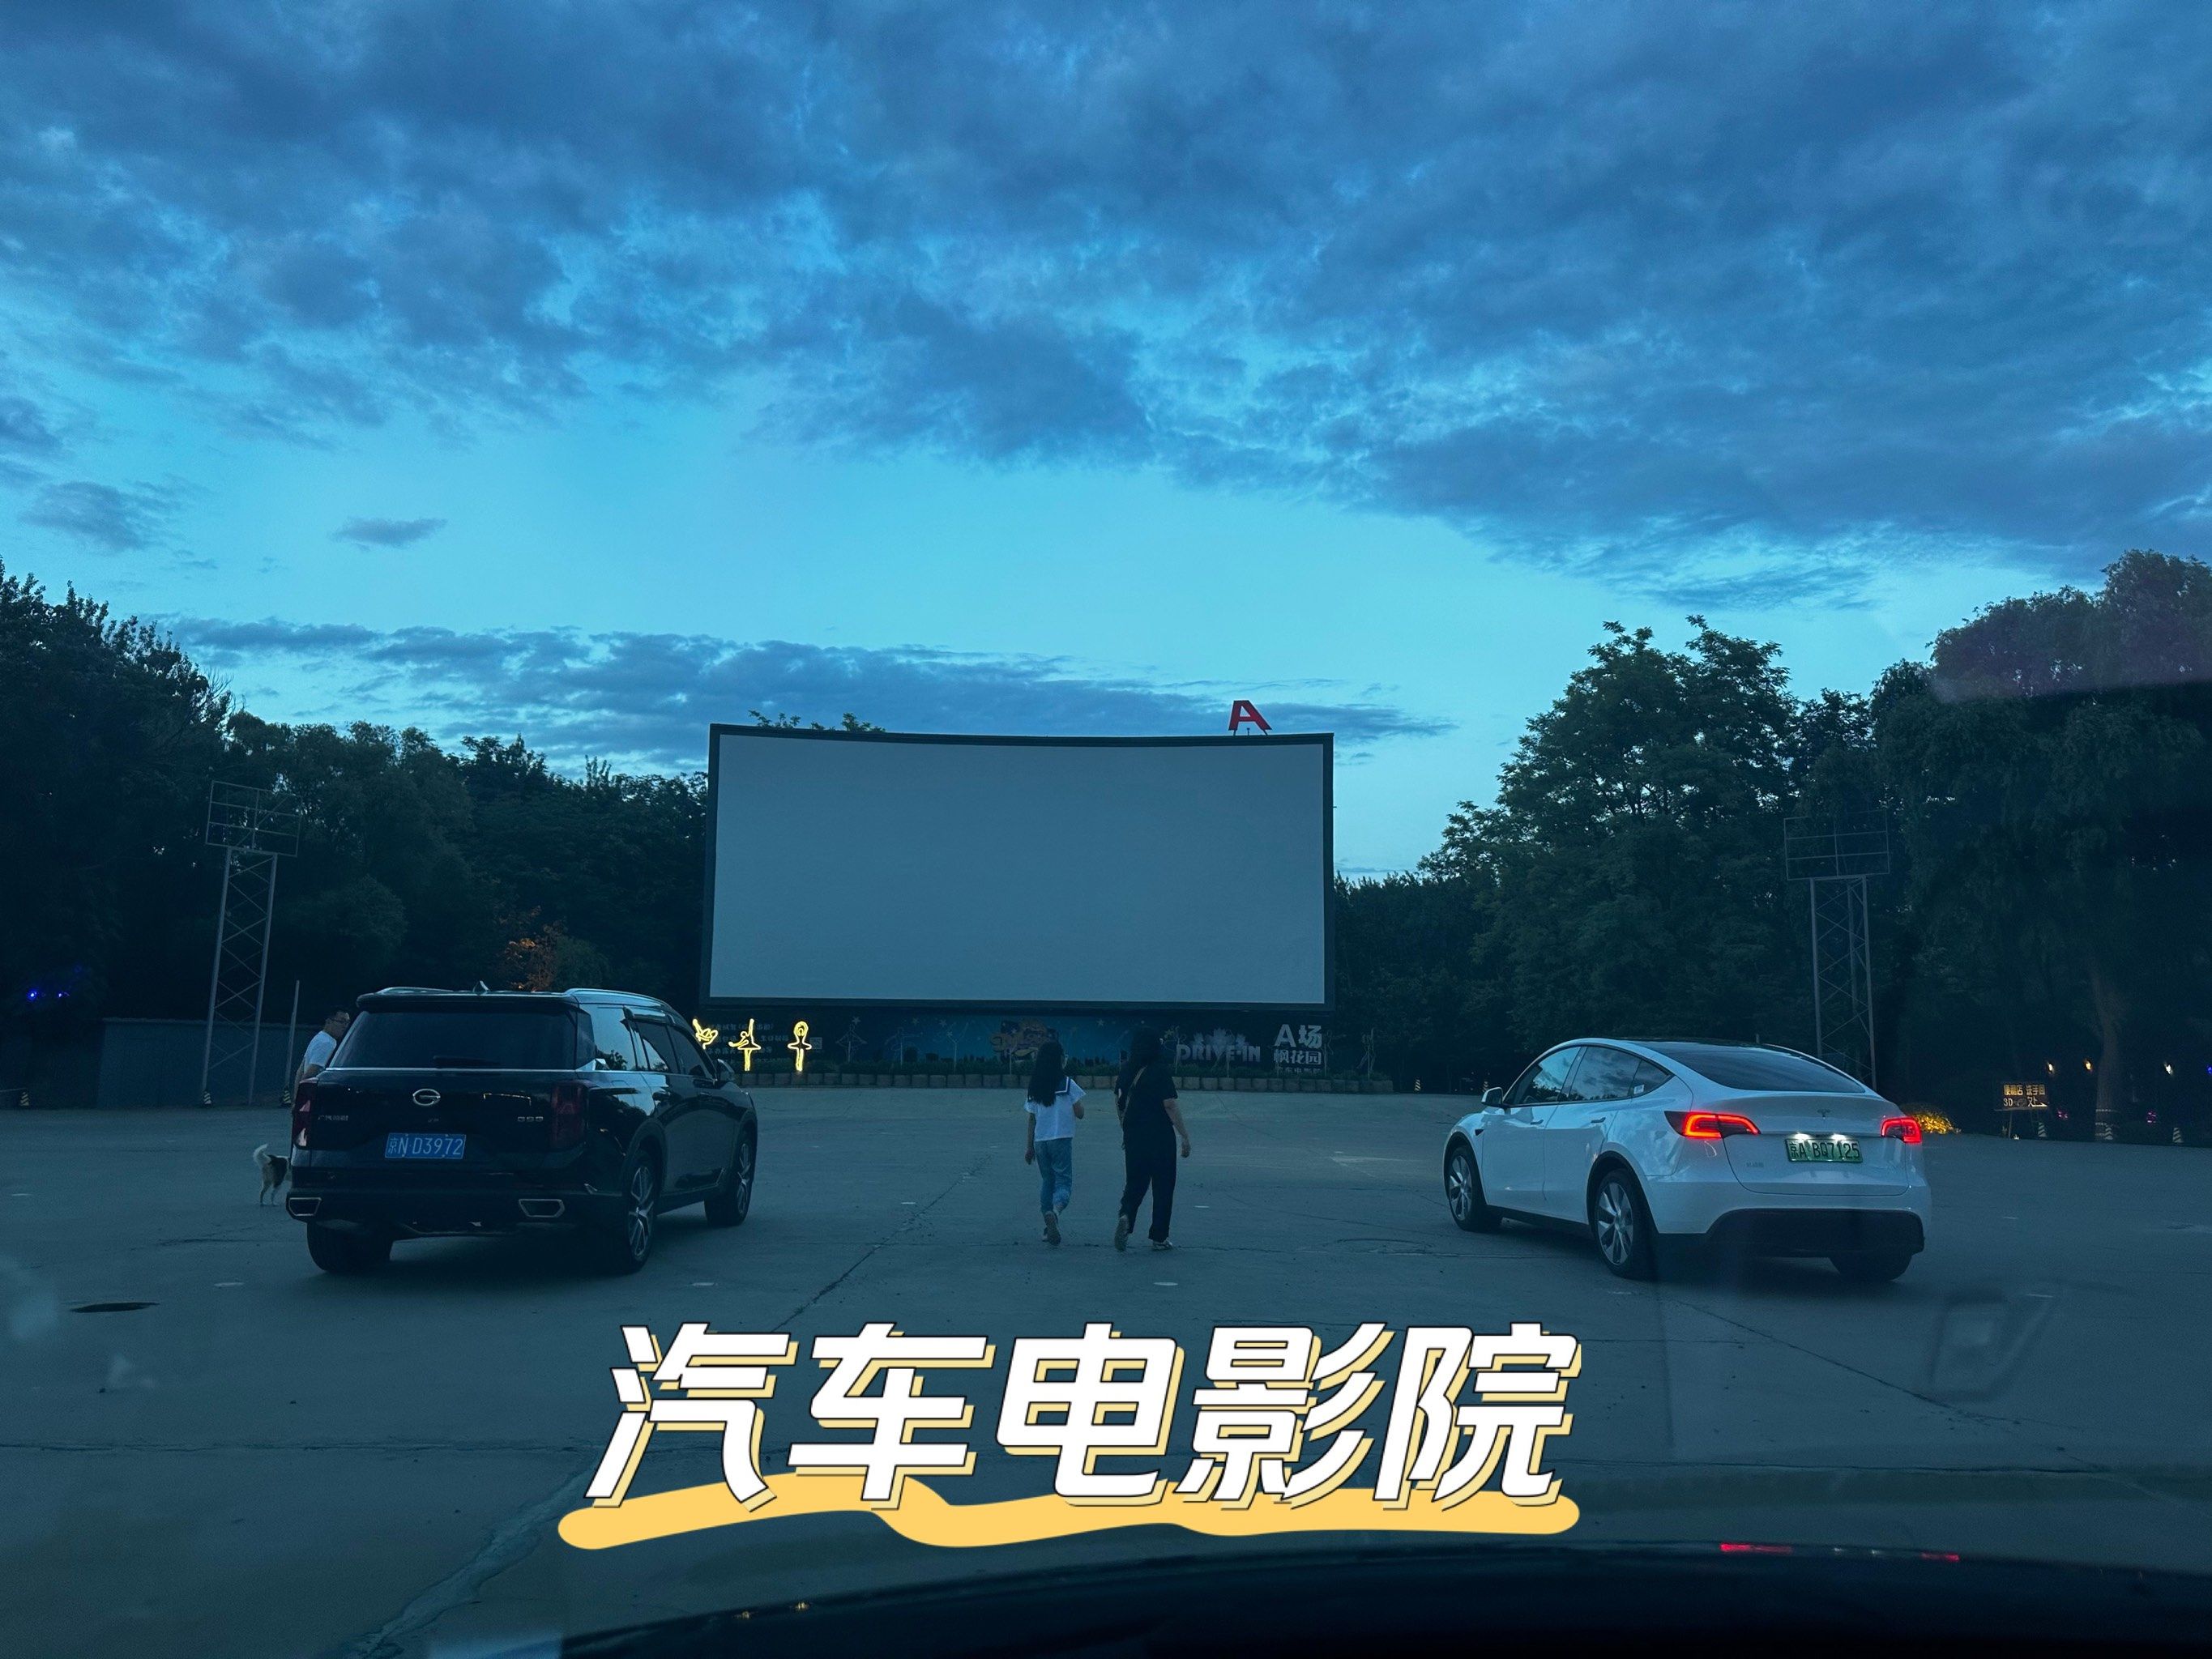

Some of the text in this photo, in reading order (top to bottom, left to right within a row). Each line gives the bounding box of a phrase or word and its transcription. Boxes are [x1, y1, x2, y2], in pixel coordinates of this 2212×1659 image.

[1228, 700, 1272, 731] A
[1274, 1024, 1322, 1049] A场
[1273, 1049, 1322, 1064] 枫花园
